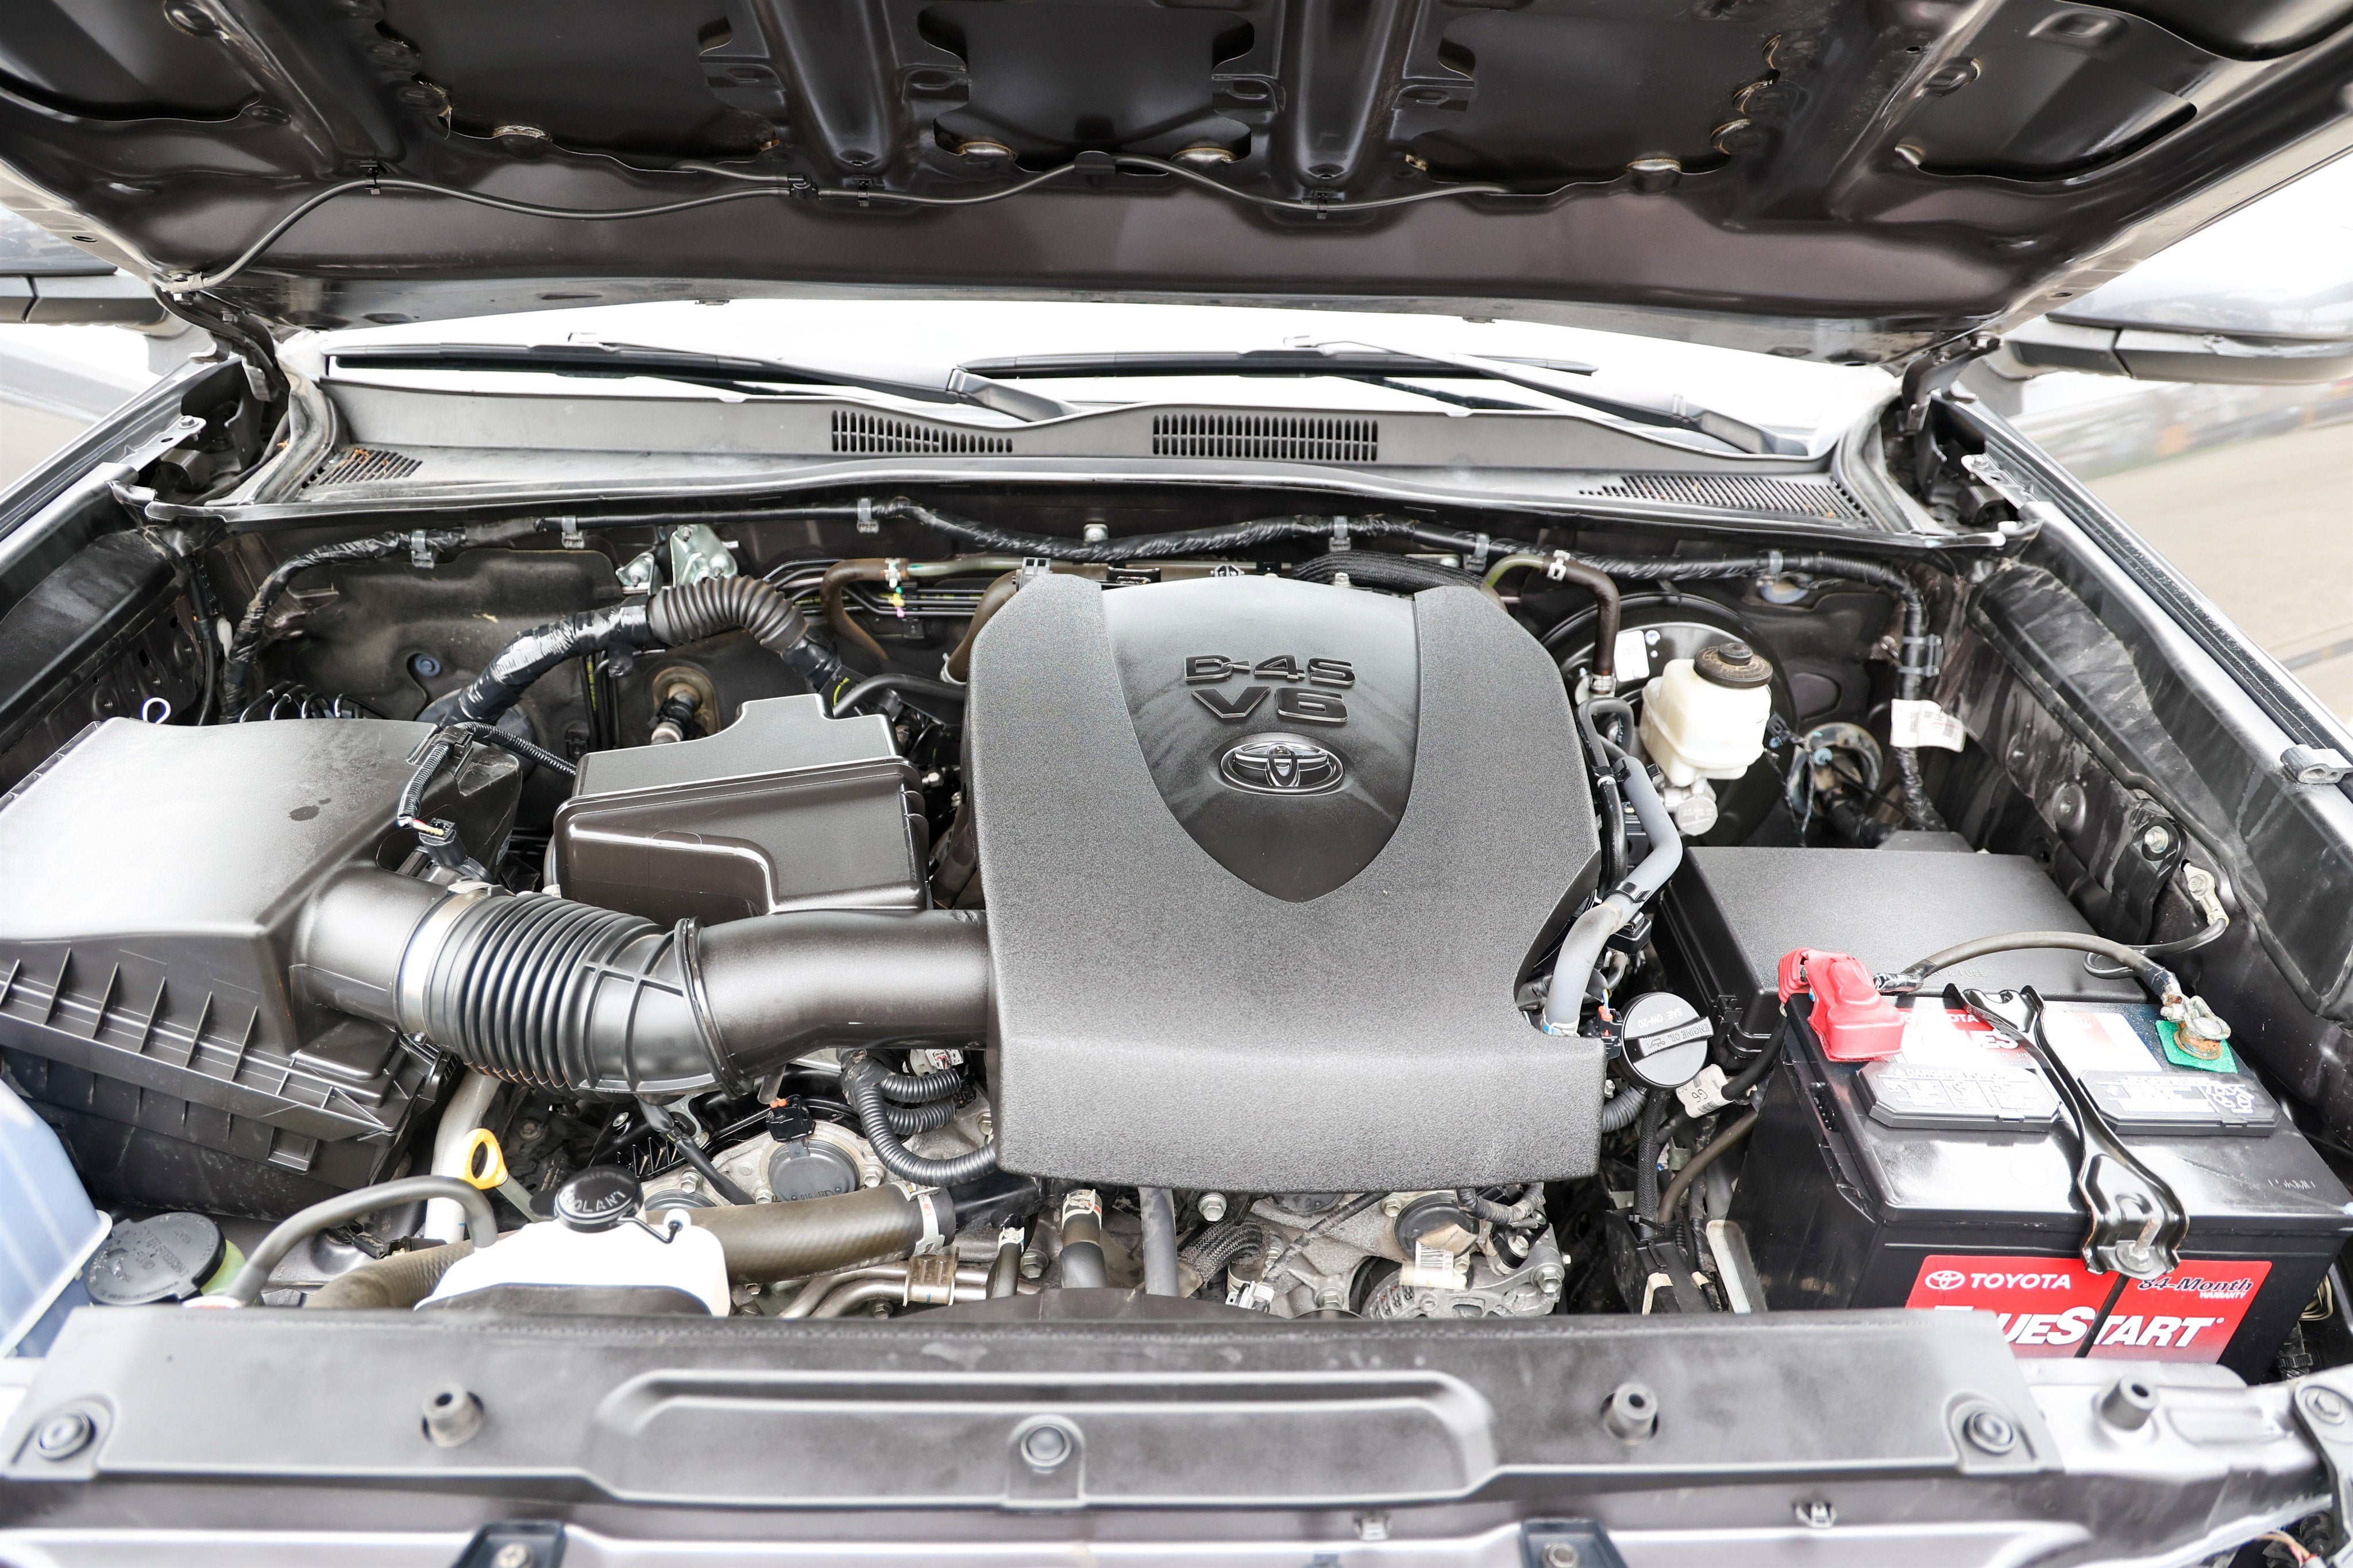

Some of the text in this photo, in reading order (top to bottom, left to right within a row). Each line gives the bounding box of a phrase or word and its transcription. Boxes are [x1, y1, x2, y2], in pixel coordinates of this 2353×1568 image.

[1185, 654, 1356, 686] D-4S
[1191, 686, 1349, 723] V6
[1667, 1007, 1684, 1020] SAE
[1668, 1023, 1711, 1043] ENGINE OIL
[562, 1189, 626, 1212] COOLANT
[1970, 1273, 2071, 1289] TOYOTA
[2138, 1276, 2254, 1291] 84-Month
[2200, 1291, 2247, 1299] WARRANTY
[1934, 1306, 2216, 1347] UESTART
